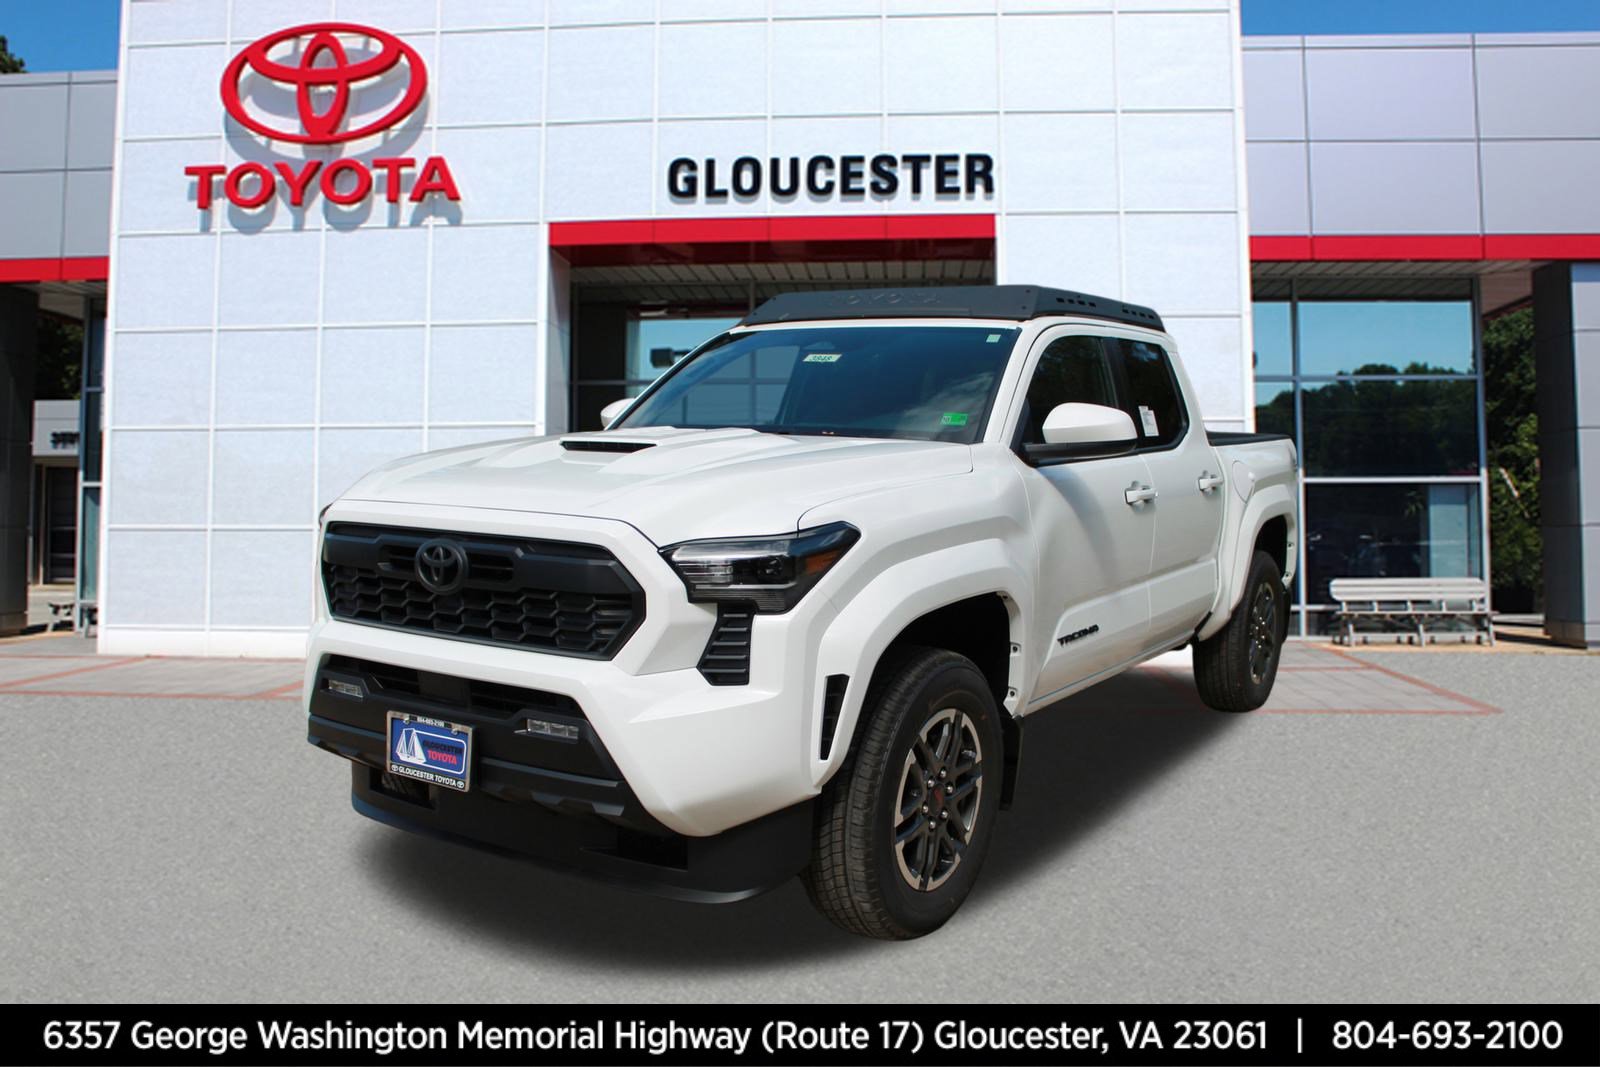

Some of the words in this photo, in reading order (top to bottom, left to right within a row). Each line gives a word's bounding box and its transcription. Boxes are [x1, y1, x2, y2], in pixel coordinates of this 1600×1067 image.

[185, 156, 461, 209] TOYOTA
[669, 154, 994, 200] GLOUCESTER
[1057, 624, 1099, 646] TACOMA
[427, 749, 457, 765] TOYOTA
[398, 766, 434, 781] GLOUCESTER
[435, 774, 456, 787] TOYOTA
